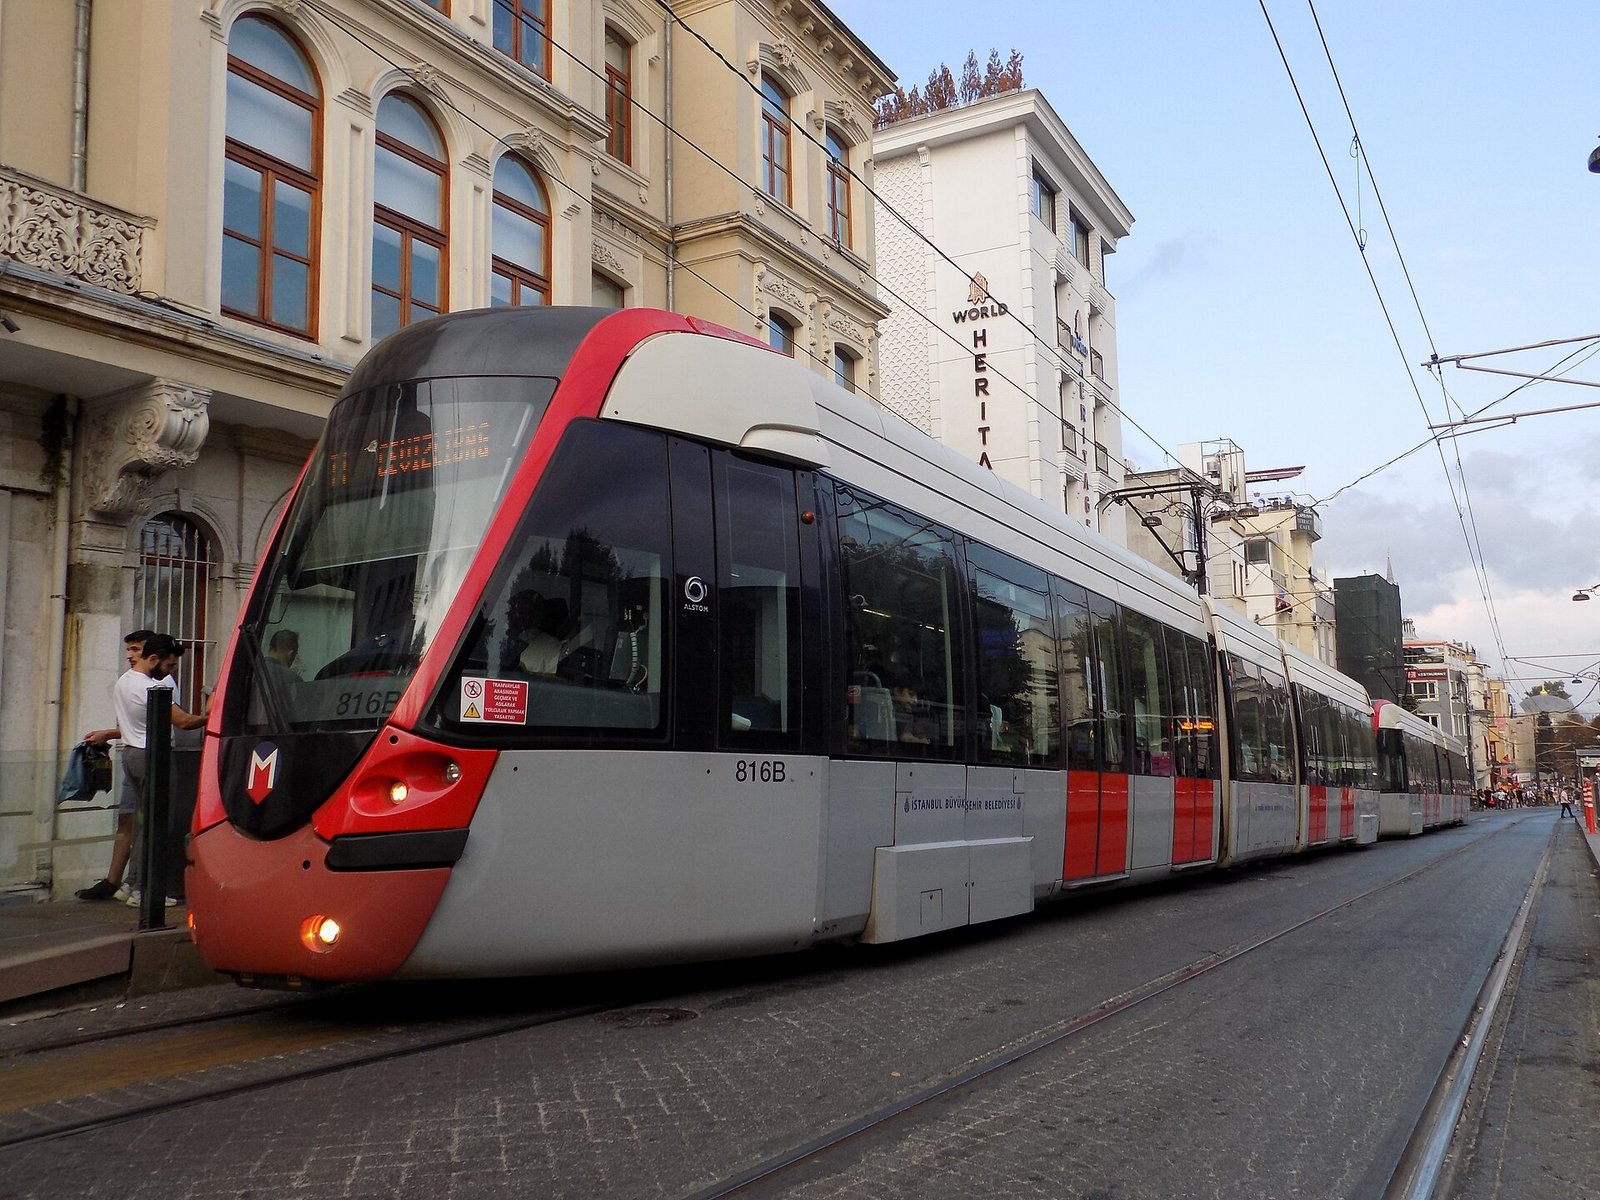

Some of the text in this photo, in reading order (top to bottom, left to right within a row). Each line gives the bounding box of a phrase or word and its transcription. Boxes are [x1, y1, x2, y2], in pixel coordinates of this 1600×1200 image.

[952, 303, 1009, 324] WORLD
[683, 602, 709, 613] ALSTOM
[735, 759, 786, 783] 816B
[911, 796, 943, 810] İSTANBUL
[984, 797, 1016, 810] BELEDİYESİ
